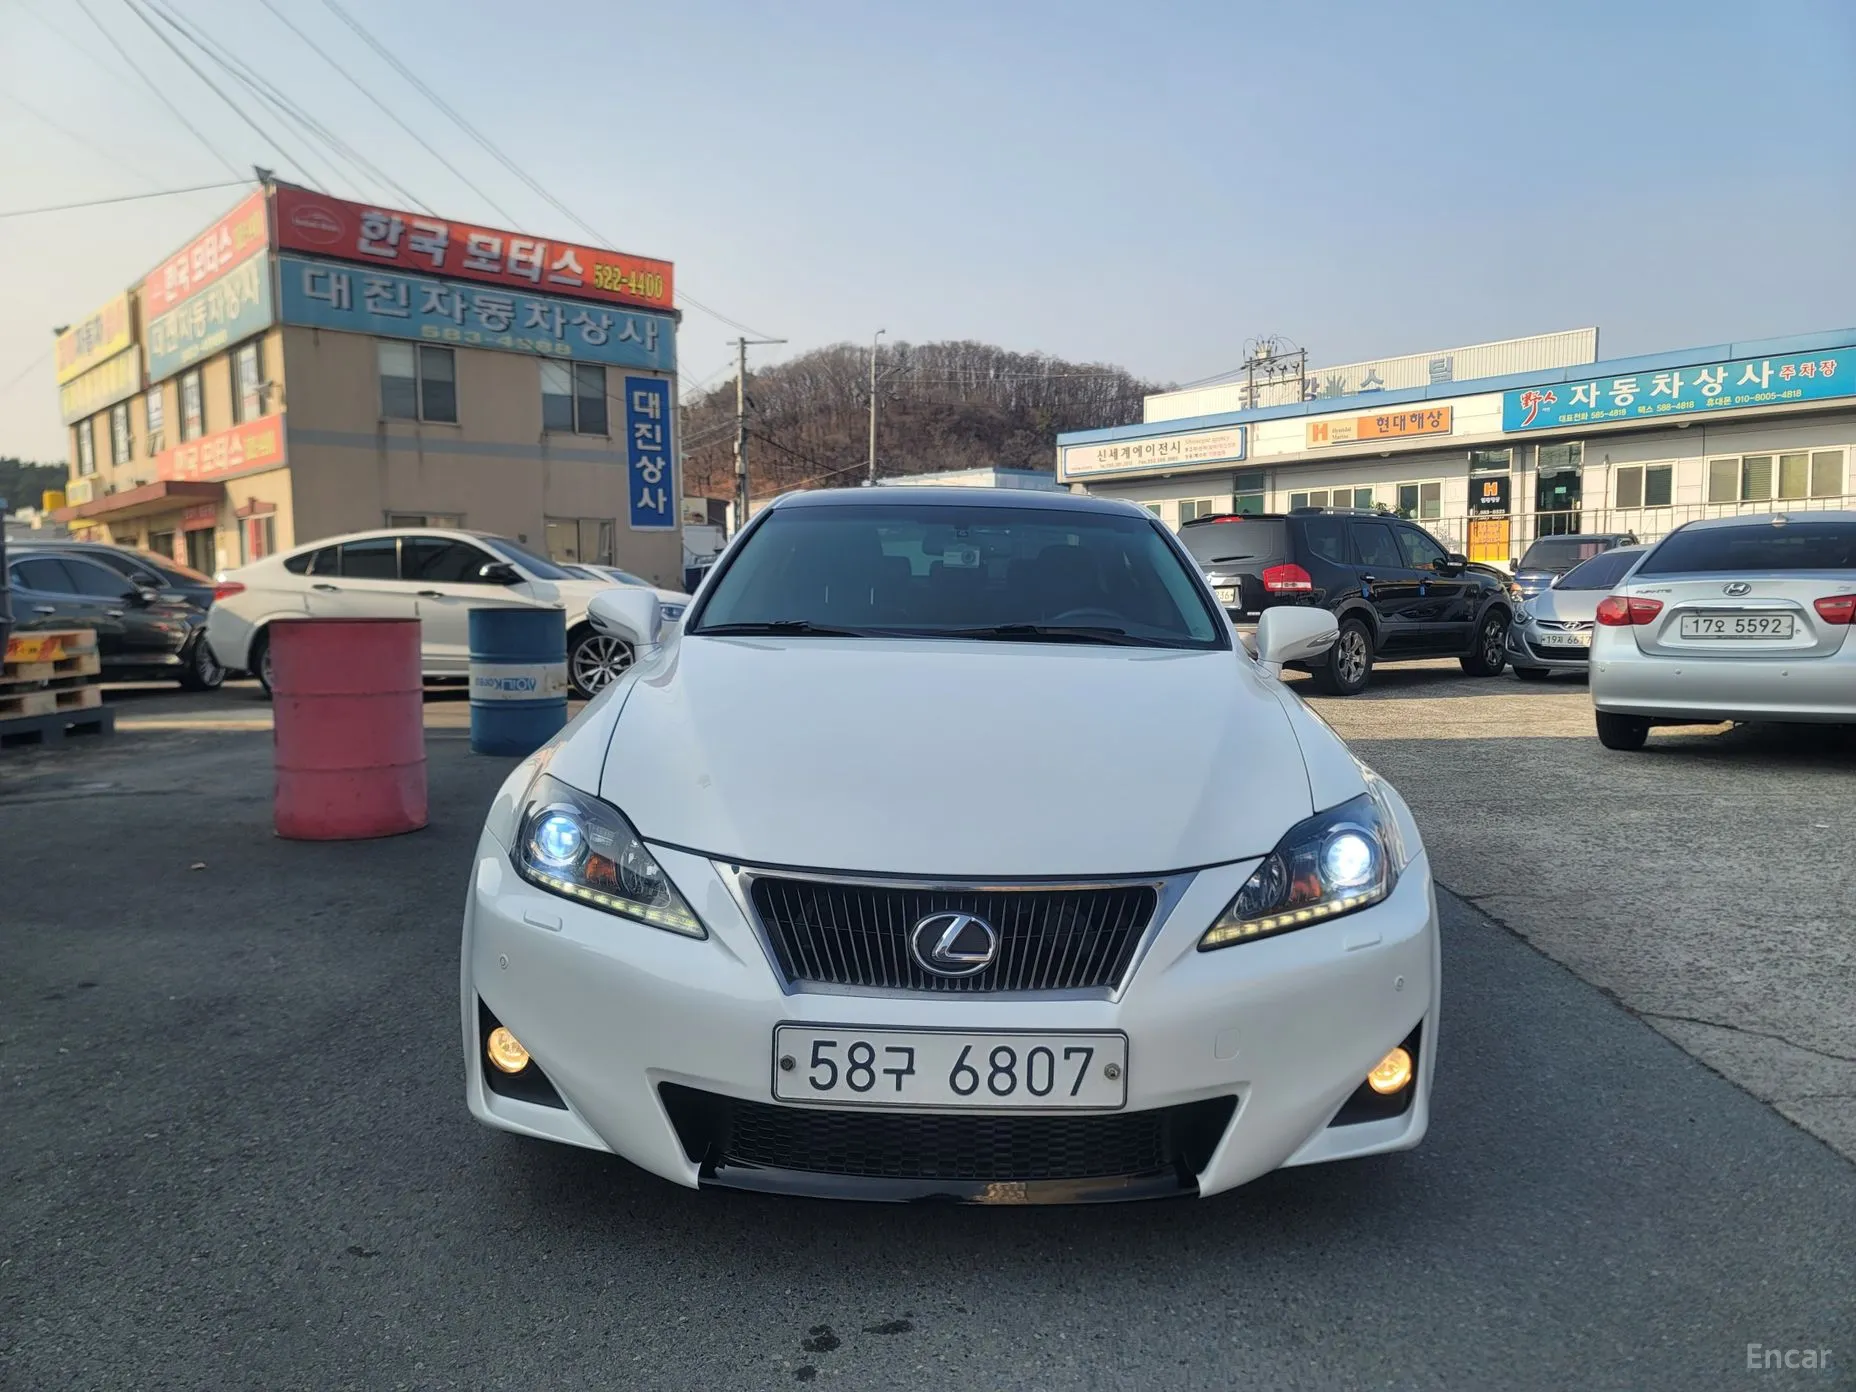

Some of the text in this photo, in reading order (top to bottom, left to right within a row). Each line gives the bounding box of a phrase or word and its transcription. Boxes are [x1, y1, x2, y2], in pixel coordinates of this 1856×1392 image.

[357, 211, 663, 299] 한국 모터스 522-4400
[303, 267, 660, 352] 대진자동차상사
[1559, 411, 1588, 422] 대표전화
[1657, 401, 1694, 411] 588-4818
[1735, 389, 1802, 403] 010-8005-4818
[1569, 360, 1837, 408] 자동차상사 주차장
[1376, 410, 1443, 433] 현대해상
[633, 390, 667, 514] 대진상사
[1097, 441, 1181, 462] 신세계에이전시
[1692, 618, 1782, 633] 17오 5592
[809, 1040, 1094, 1097] 58구 6807
